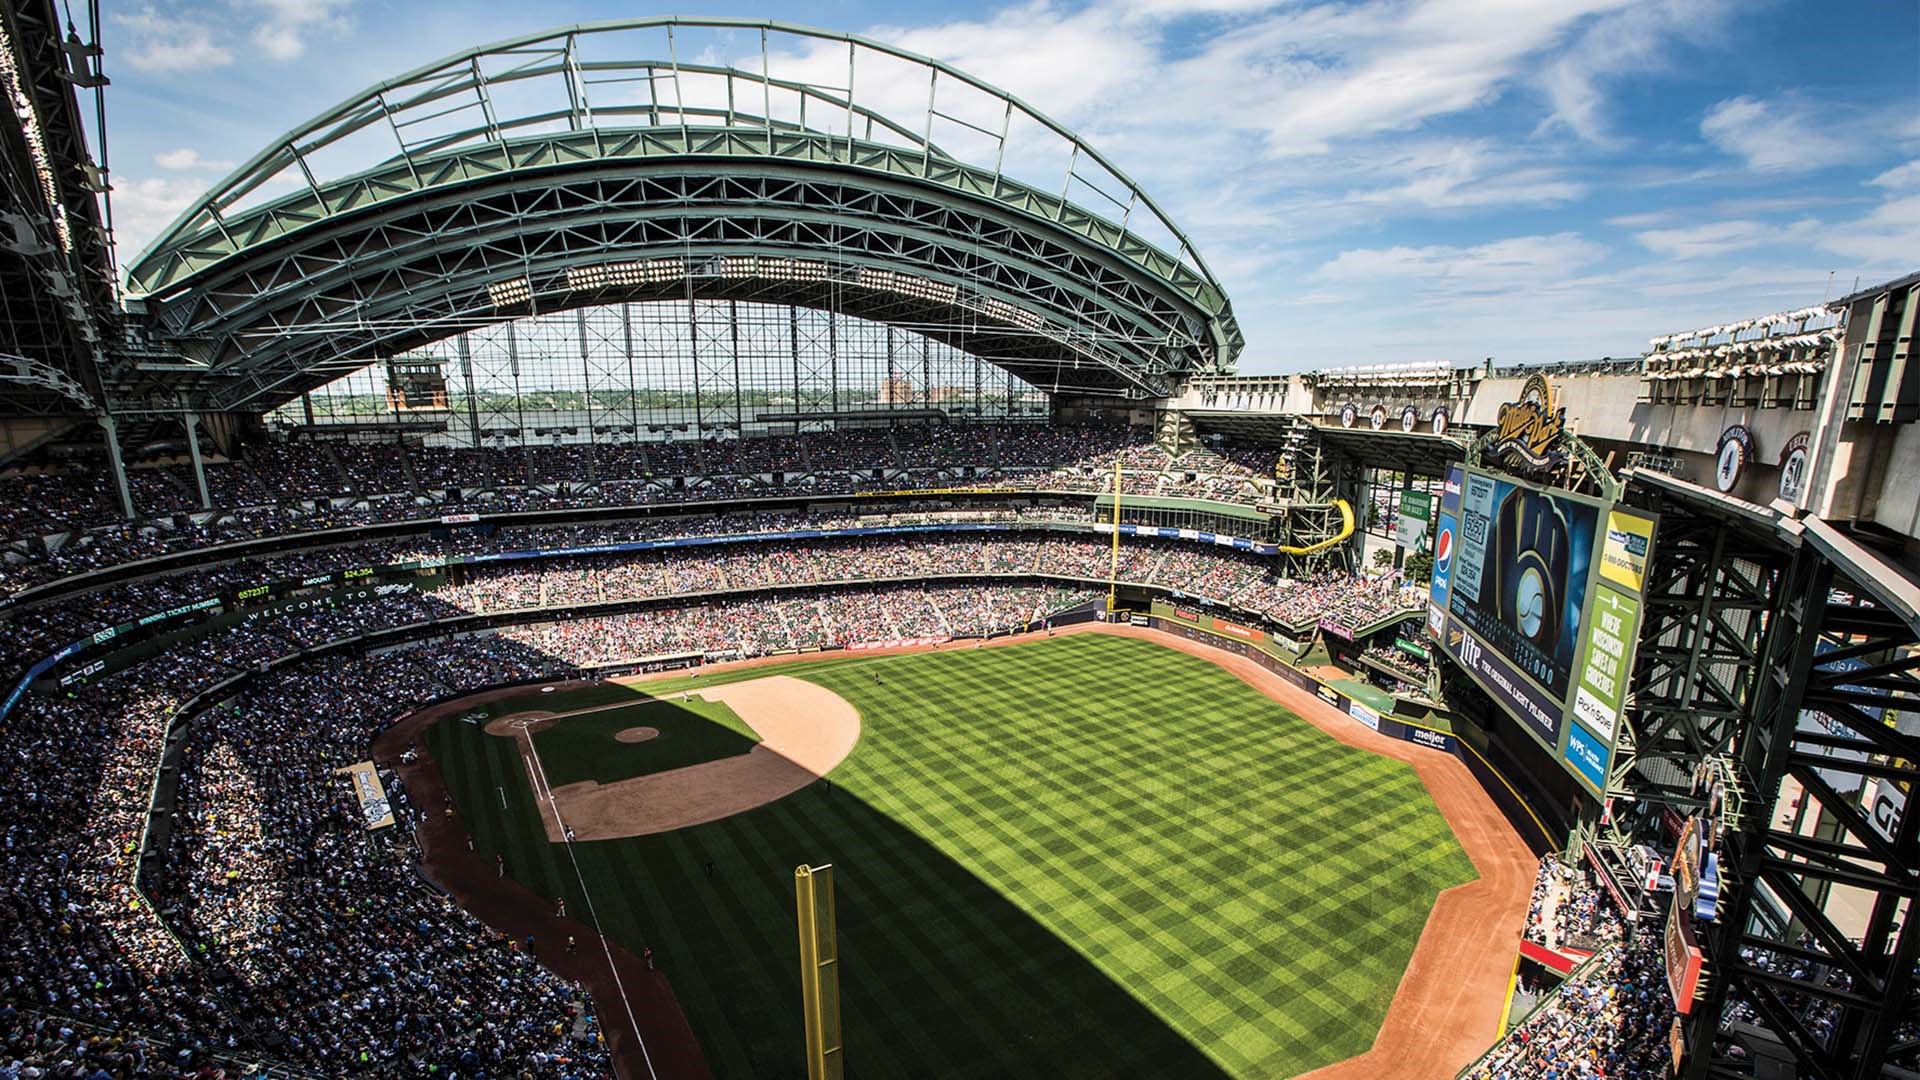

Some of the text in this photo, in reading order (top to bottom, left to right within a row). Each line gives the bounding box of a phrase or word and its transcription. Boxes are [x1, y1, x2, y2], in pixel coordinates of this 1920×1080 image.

[1498, 402, 1535, 440] Miller
[1524, 408, 1563, 455] Park
[1722, 450, 1734, 480] 4
[138, 611, 166, 626] WINNING
[166, 604, 192, 618] TICKET
[191, 597, 221, 611] NUMBER
[238, 585, 270, 600] 6572377
[302, 575, 332, 586] AMOUNT
[248, 596, 333, 621] WELCOME
[345, 590, 367, 600] TO
[1601, 610, 1622, 637] WHERE
[1460, 629, 1481, 669] Lite
[1592, 626, 1625, 660] WISCONSIN
[1590, 646, 1618, 678] SAVES ON
[1481, 659, 1491, 676] THE
[1490, 667, 1513, 695] ORIGINAL
[1512, 687, 1530, 709] LIGHT
[1595, 709, 1612, 730] Save
[1414, 728, 1446, 746] meijer
[1569, 735, 1585, 756] WPS
